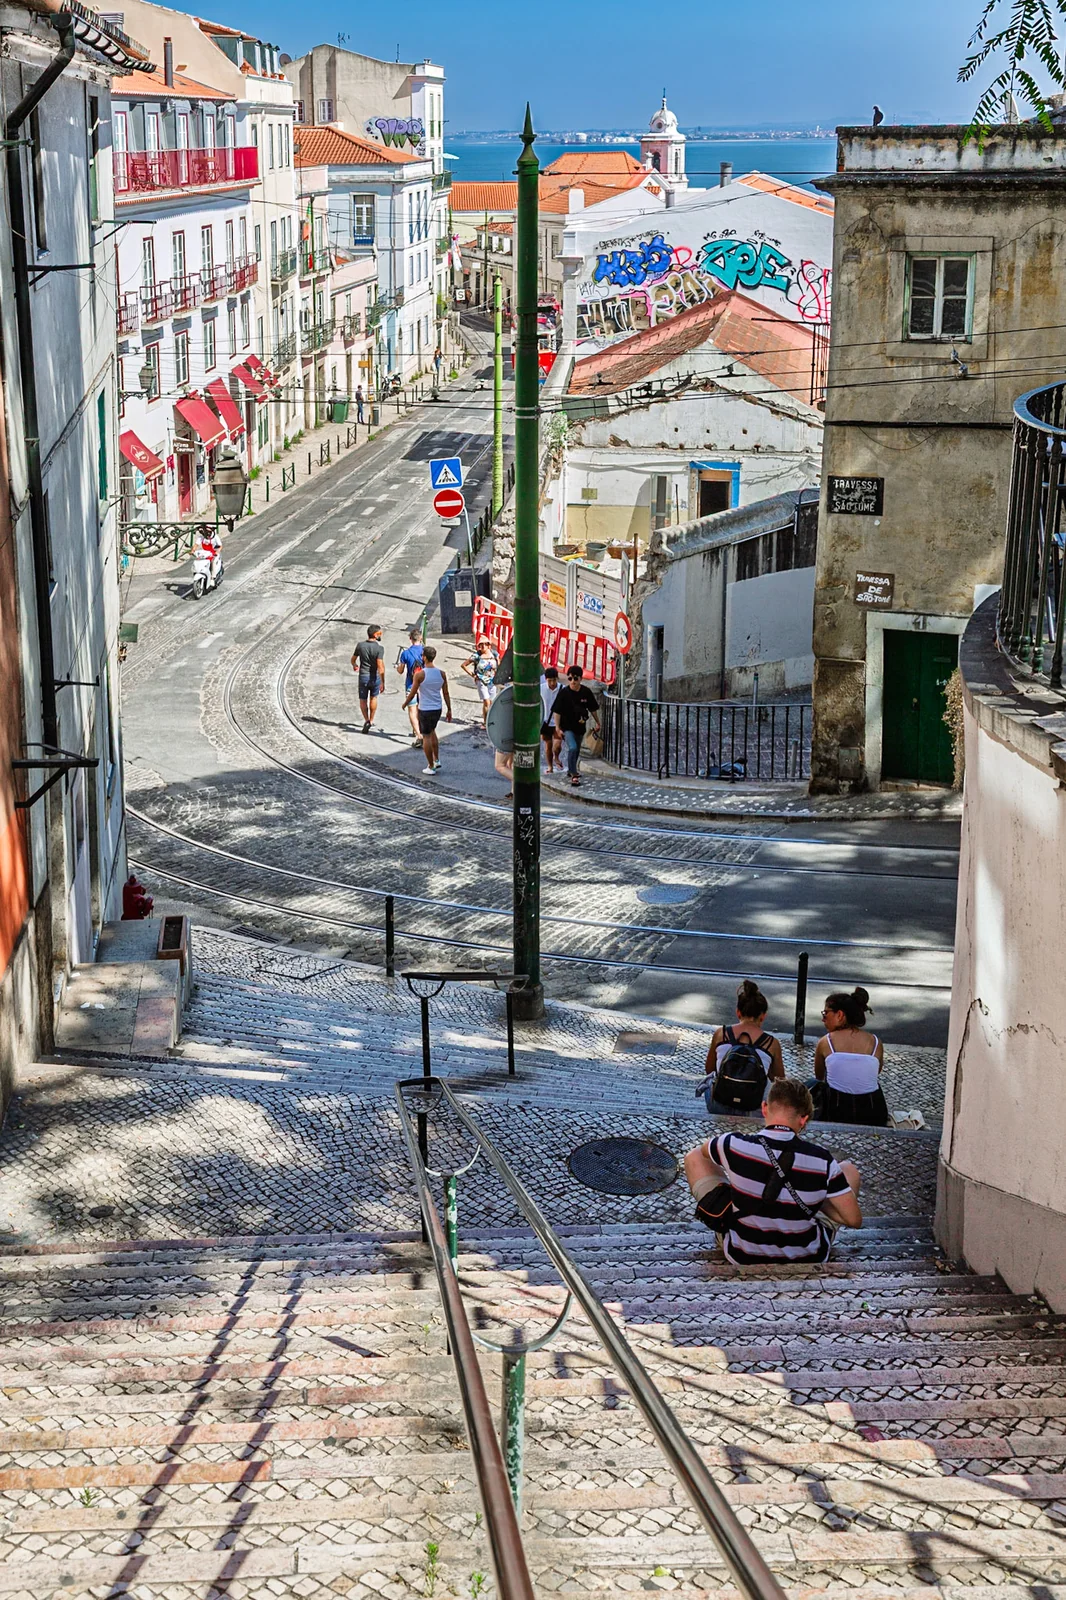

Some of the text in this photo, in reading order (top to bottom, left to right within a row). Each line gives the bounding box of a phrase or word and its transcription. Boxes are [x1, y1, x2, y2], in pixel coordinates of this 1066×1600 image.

[834, 479, 878, 491] TRAVESSA
[867, 585, 883, 594] DE
[758, 1136, 786, 1178] SUPREME
